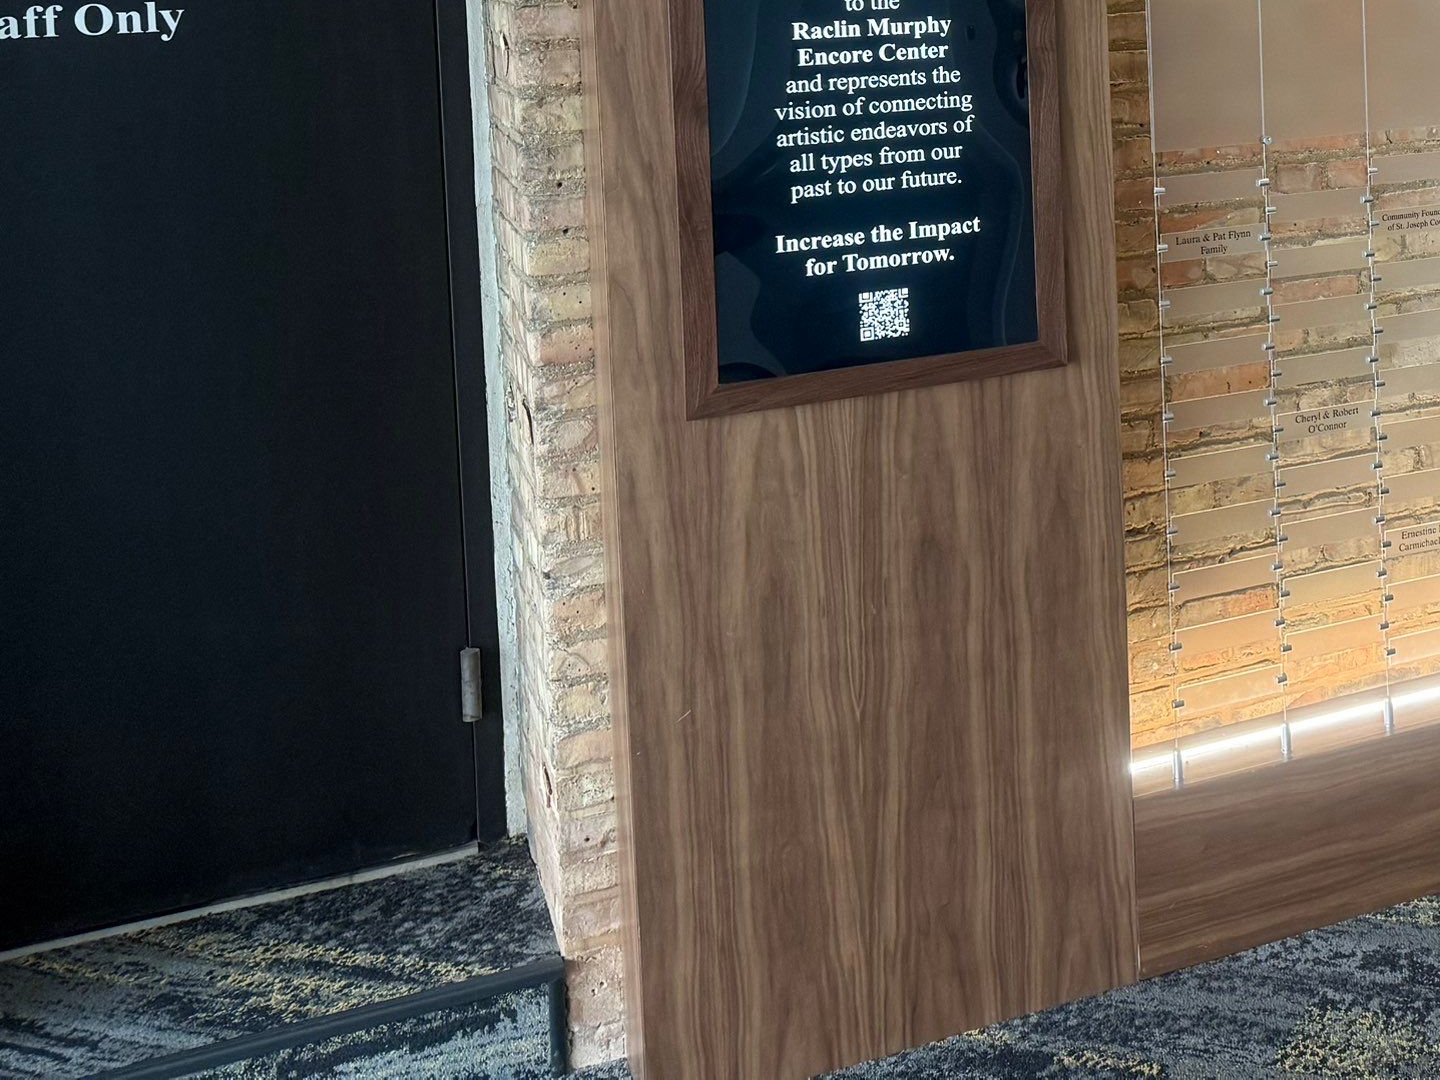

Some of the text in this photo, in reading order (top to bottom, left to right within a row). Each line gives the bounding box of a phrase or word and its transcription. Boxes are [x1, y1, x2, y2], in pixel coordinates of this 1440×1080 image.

[0, 1, 185, 41] aff Only
[792, 16, 951, 41] Raclin Murphy
[798, 42, 948, 67] Encore Center
[786, 66, 961, 94] and represents the
[775, 92, 973, 121] vision of connecting
[776, 114, 975, 147] artistic endeavors of
[790, 144, 962, 175] all types from our
[790, 168, 962, 204] past to our future.
[1381, 211, 1419, 222] Community
[1395, 221, 1406, 230] St.
[1408, 220, 1429, 231] Joseph
[775, 216, 981, 254] Increase the Impact
[1175, 228, 1251, 246] Laura & Pat Flynn
[805, 245, 955, 277] for Tomorrow.
[1200, 243, 1228, 255] Family
[1295, 407, 1359, 426] Cheryl & Robert
[1308, 421, 1347, 434] O'Connor
[1401, 526, 1437, 539] Ernestine
